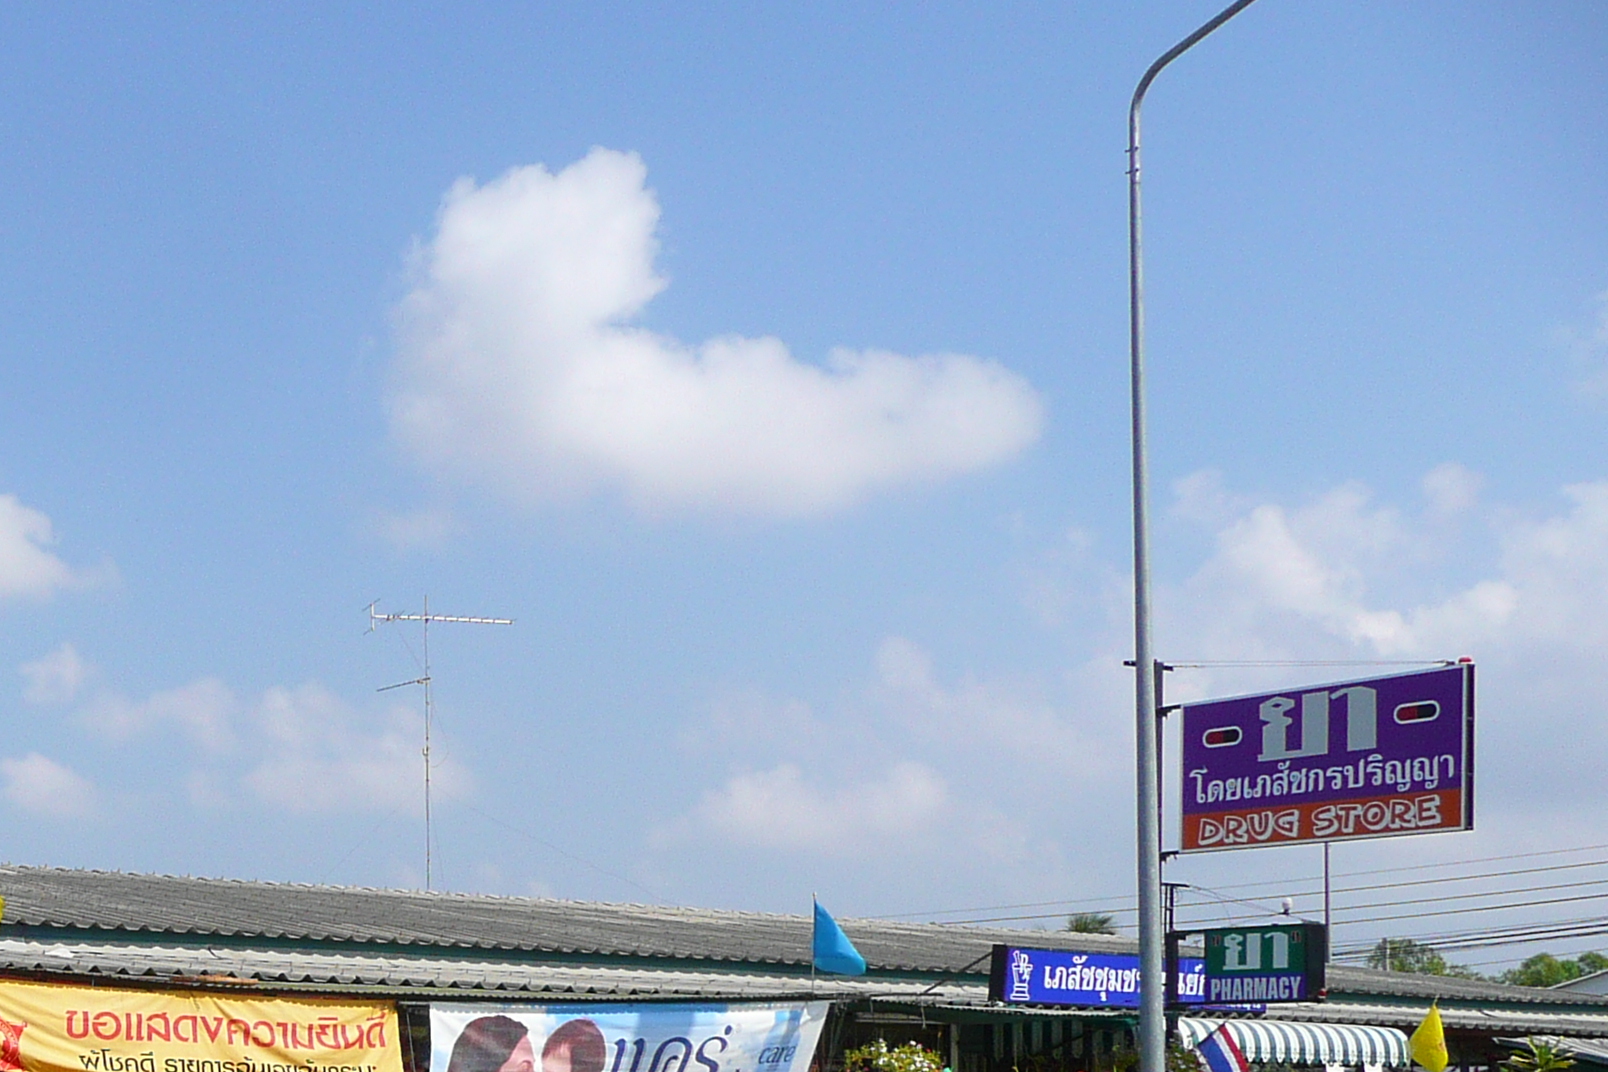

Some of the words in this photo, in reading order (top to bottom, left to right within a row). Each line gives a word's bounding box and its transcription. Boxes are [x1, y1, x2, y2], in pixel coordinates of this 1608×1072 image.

[1257, 686, 1378, 762] ยา
[1189, 753, 1455, 804] โดยเภสัชกรปริญญา
[1198, 808, 1300, 846] DRUG
[1311, 794, 1442, 837] STORE
[1210, 975, 1301, 1001] PHARMACY
[66, 1010, 388, 1050] ขอแสดงความยินดี
[758, 1044, 797, 1065] care
